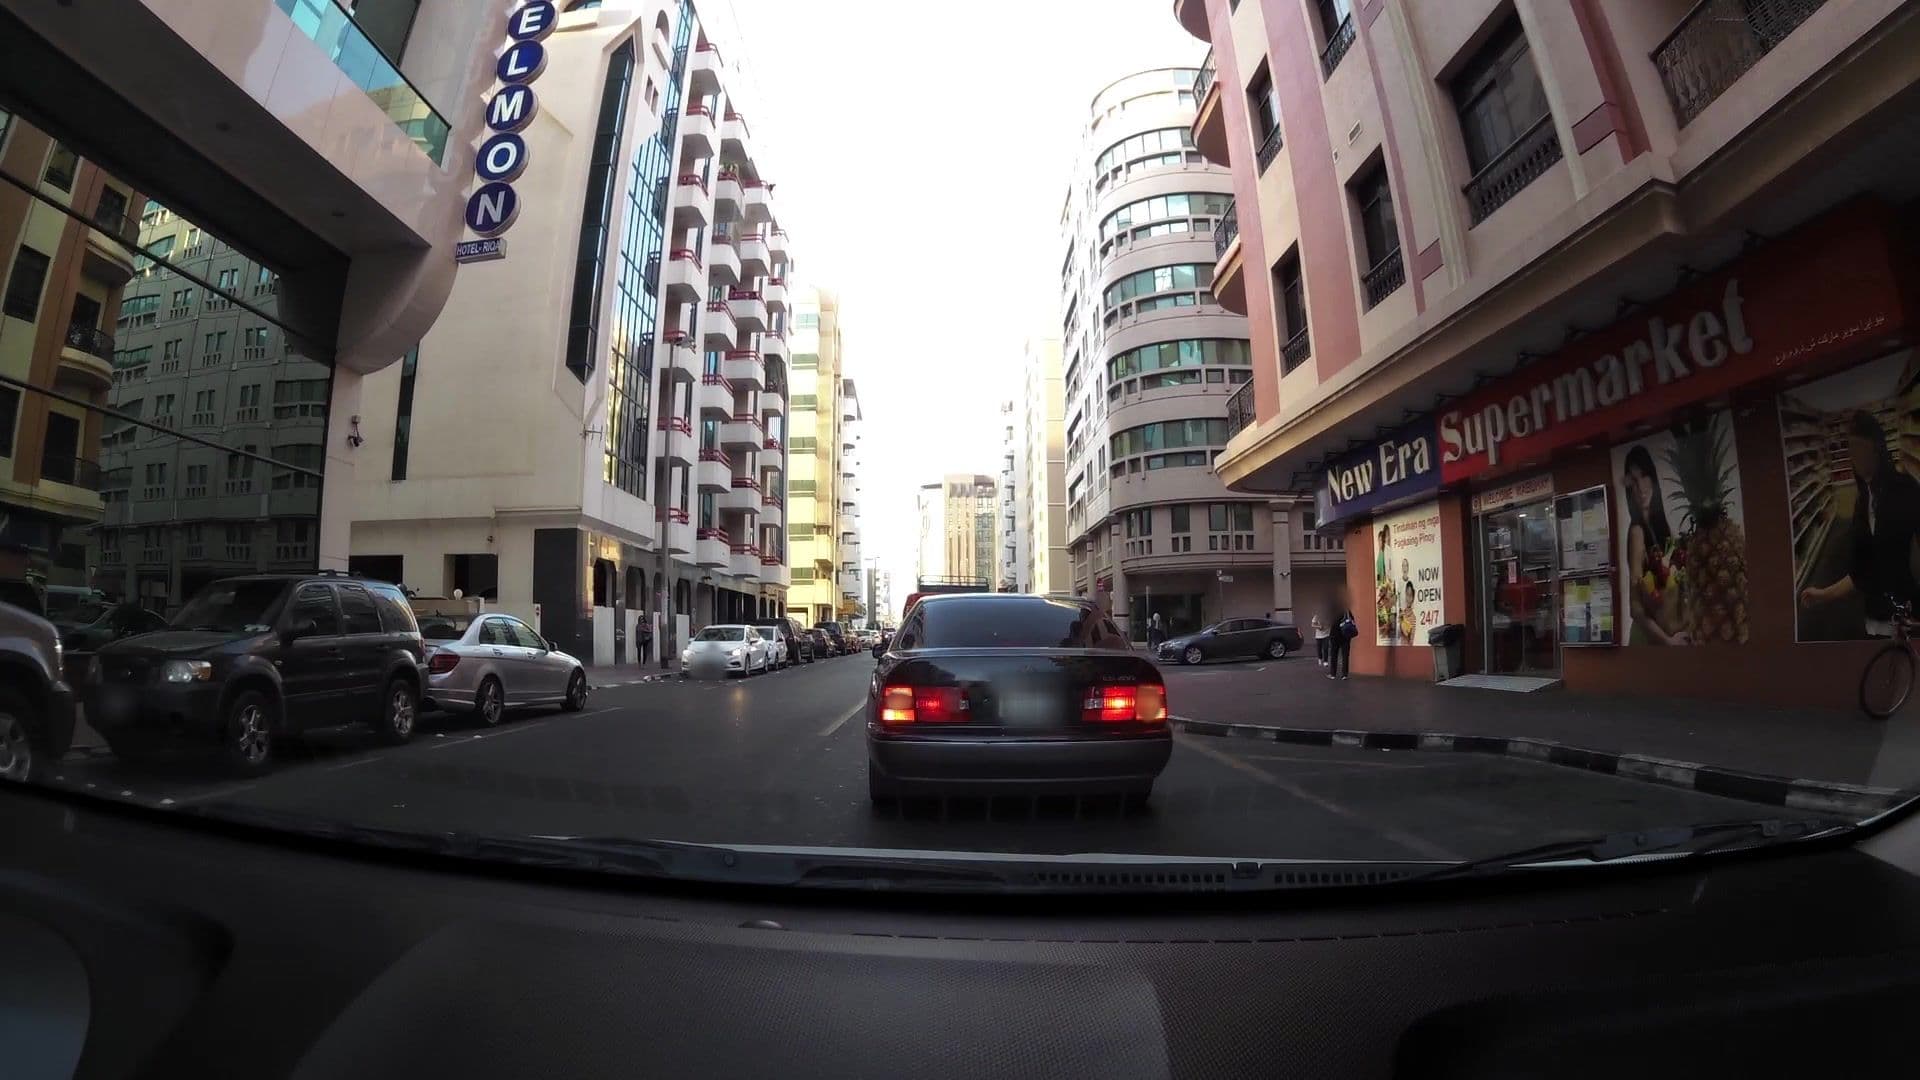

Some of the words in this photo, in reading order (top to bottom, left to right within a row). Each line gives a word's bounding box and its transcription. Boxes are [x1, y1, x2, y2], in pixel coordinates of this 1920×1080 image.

[1327, 459, 1374, 507] New
[1379, 436, 1430, 486] Era
[1440, 277, 1753, 466] Supermarket
[1418, 567, 1440, 582] NOW
[1417, 588, 1442, 603] OPEN
[1420, 610, 1440, 626] 24/7
